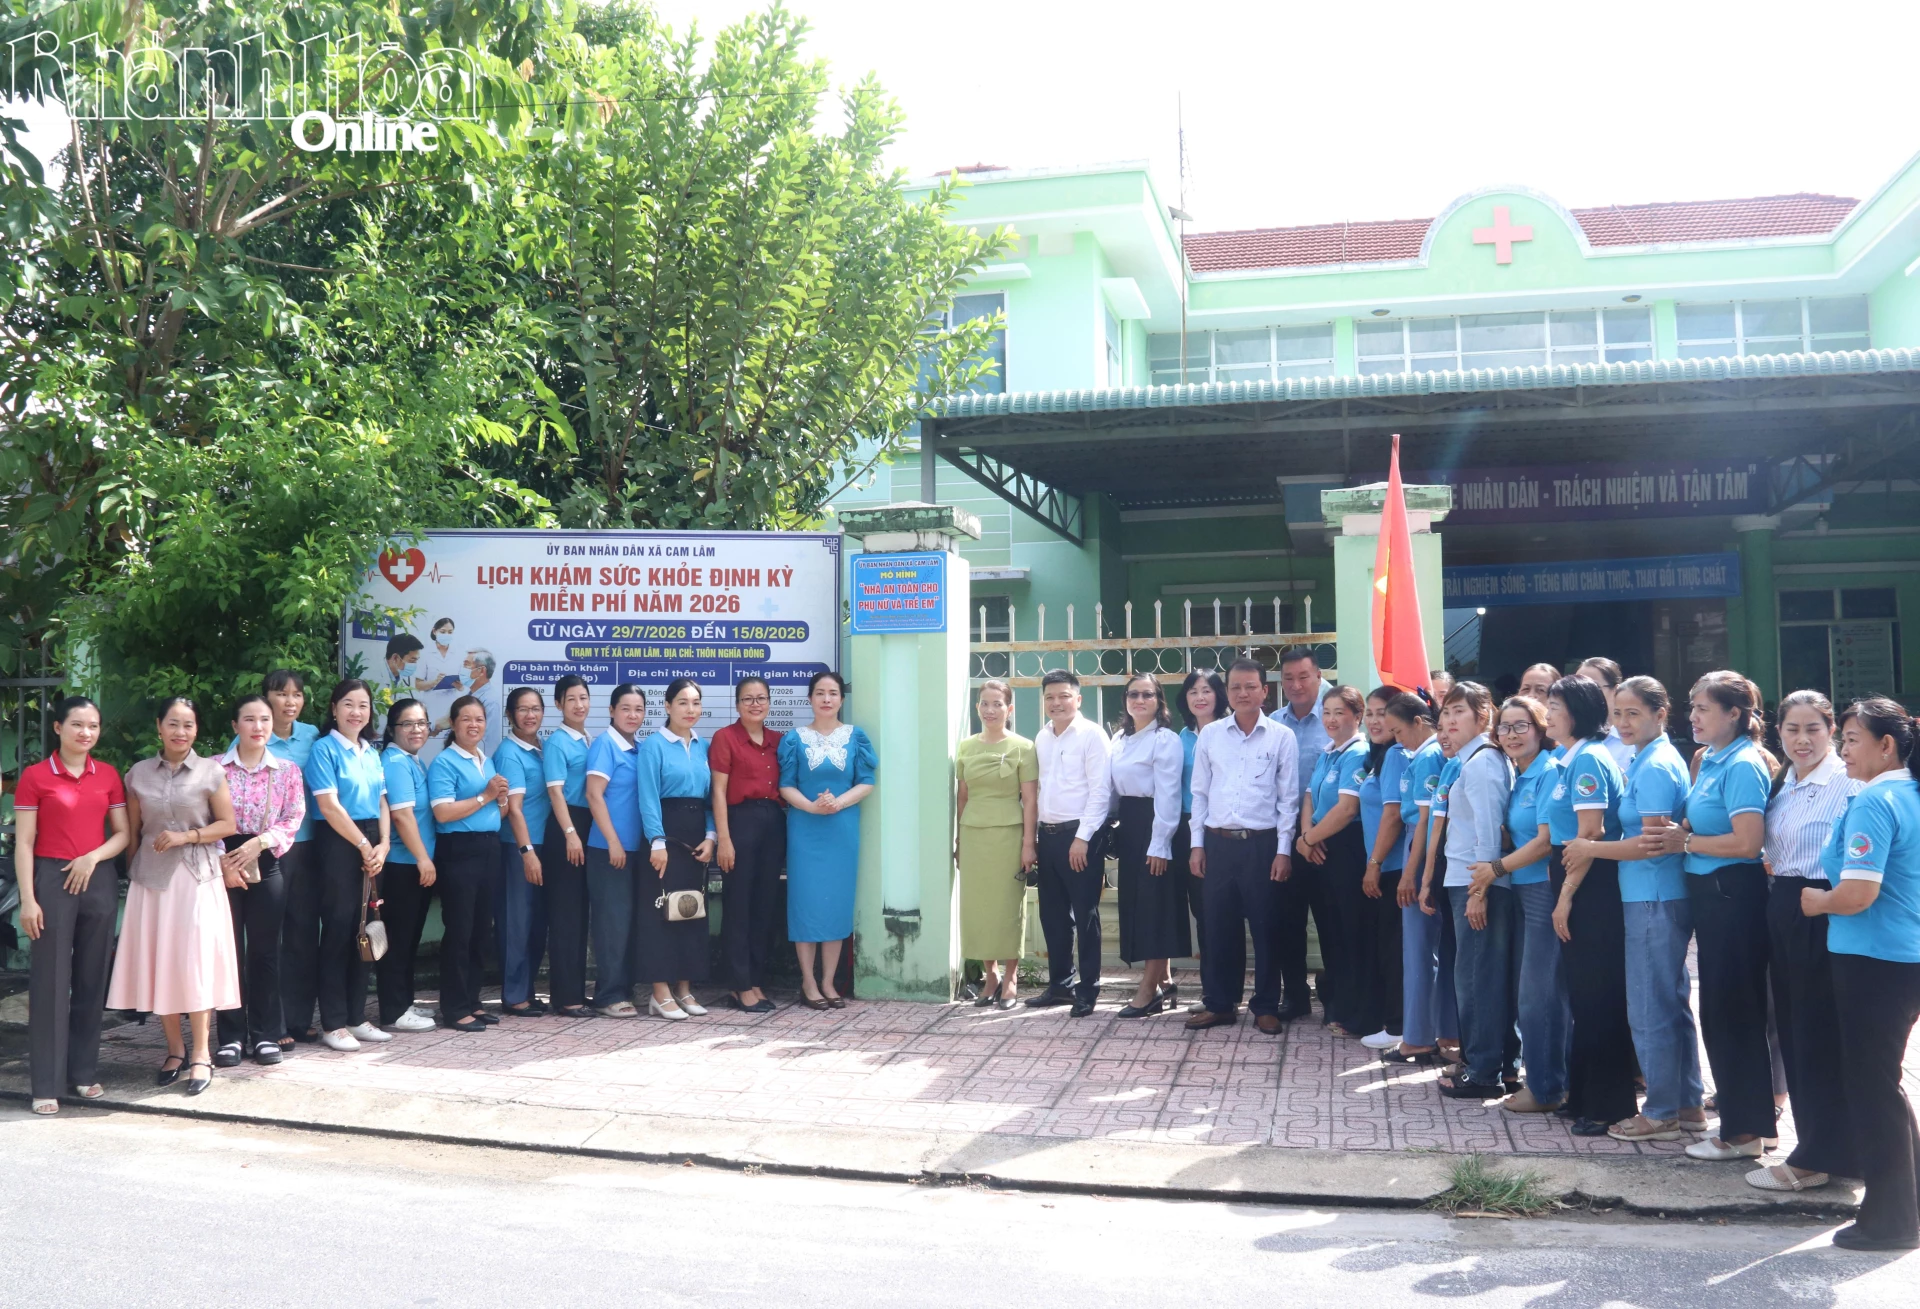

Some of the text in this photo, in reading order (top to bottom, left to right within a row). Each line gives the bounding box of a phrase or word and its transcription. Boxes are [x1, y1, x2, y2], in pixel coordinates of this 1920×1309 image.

[1462, 476, 1504, 510] NHÂN
[1508, 475, 1539, 509] DÂN
[1553, 473, 1601, 507] TRÁCH
[1605, 470, 1655, 511] NHIỆM
[1658, 468, 1678, 503] VÀ
[1681, 467, 1712, 508] TẬN
[546, 542, 716, 557] ỦY BAN NHÂN DÂN XÃ CAM LÂM
[477, 561, 794, 591] LỊCH KHÁM SỨC KHỎE ĐỊNH KỲ
[880, 570, 917, 579] MÔ HÌNH
[1463, 572, 1499, 599] NGHIỆM
[1501, 569, 1526, 595] SỐNG
[1533, 567, 1560, 593] TIẾNG
[1562, 568, 1578, 592] NÓI
[1635, 568, 1657, 589] THAY
[1659, 560, 1675, 587] ĐỔI
[1677, 565, 1701, 590] THỰC
[1702, 560, 1727, 586] CHẤT
[883, 584, 895, 594] AN
[897, 582, 919, 594] TOÀN
[921, 583, 938, 593] CHO
[530, 586, 741, 613] MIỄN PHÍ NĂM 2026
[858, 600, 875, 613] PHỤ
[877, 597, 889, 610] NỮ
[891, 597, 902, 610] VÀ
[904, 596, 919, 609] TRẺ
[532, 621, 806, 640] TỪ NGÀY 29/7/2026 ĐẾN 15/8/2026
[570, 647, 592, 660] TRẠM
[594, 647, 599, 657] Y
[601, 645, 610, 658] TẾ
[611, 646, 622, 658] XÃ
[624, 647, 643, 658] CAM
[643, 646, 662, 658] LÂM.
[664, 648, 677, 660] ĐỊA
[696, 647, 716, 658] THÔN
[718, 647, 742, 658] NGHĨA
[743, 647, 765, 659] ĐÔNG
[509, 663, 609, 673] Địa bàn thôn khám
[628, 668, 716, 679] Địa chỉ thôn cũ
[734, 669, 760, 678] Thời
[764, 669, 789, 680] gian
[520, 673, 545, 683] (Sau
[548, 673, 565, 682] sá
[773, 698, 787, 706] đến
